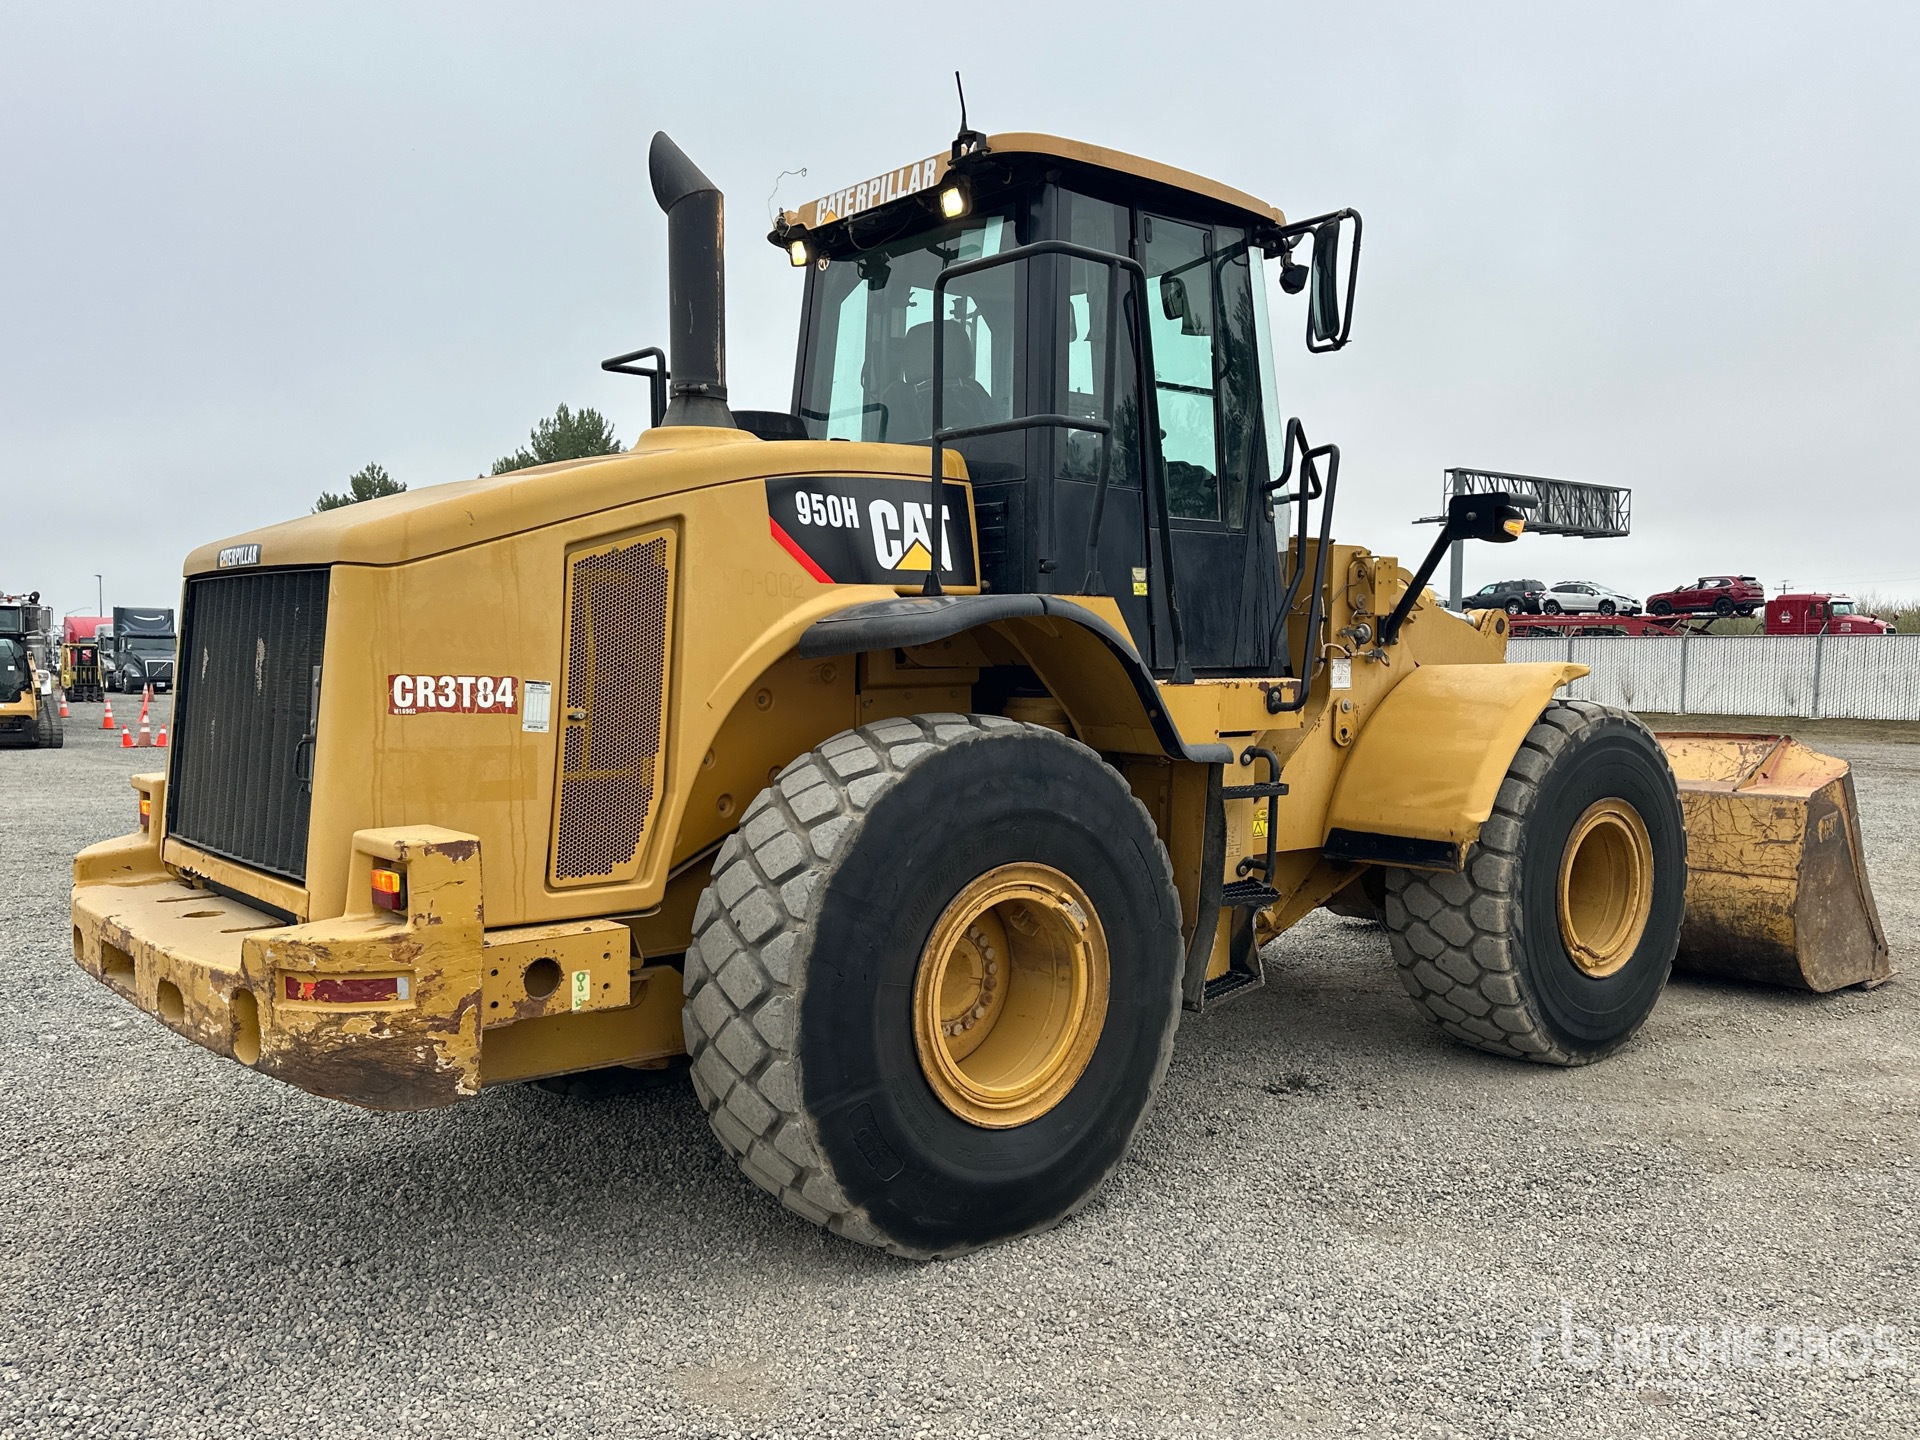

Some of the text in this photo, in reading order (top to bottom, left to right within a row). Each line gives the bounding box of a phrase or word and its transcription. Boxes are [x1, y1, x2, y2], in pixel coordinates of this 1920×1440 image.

[816, 158, 937, 227] CATERPILLAR
[795, 490, 860, 529] 950H
[868, 499, 953, 572] CAT
[219, 545, 258, 567] CATERPILLAR
[393, 674, 514, 708] CR3T84
